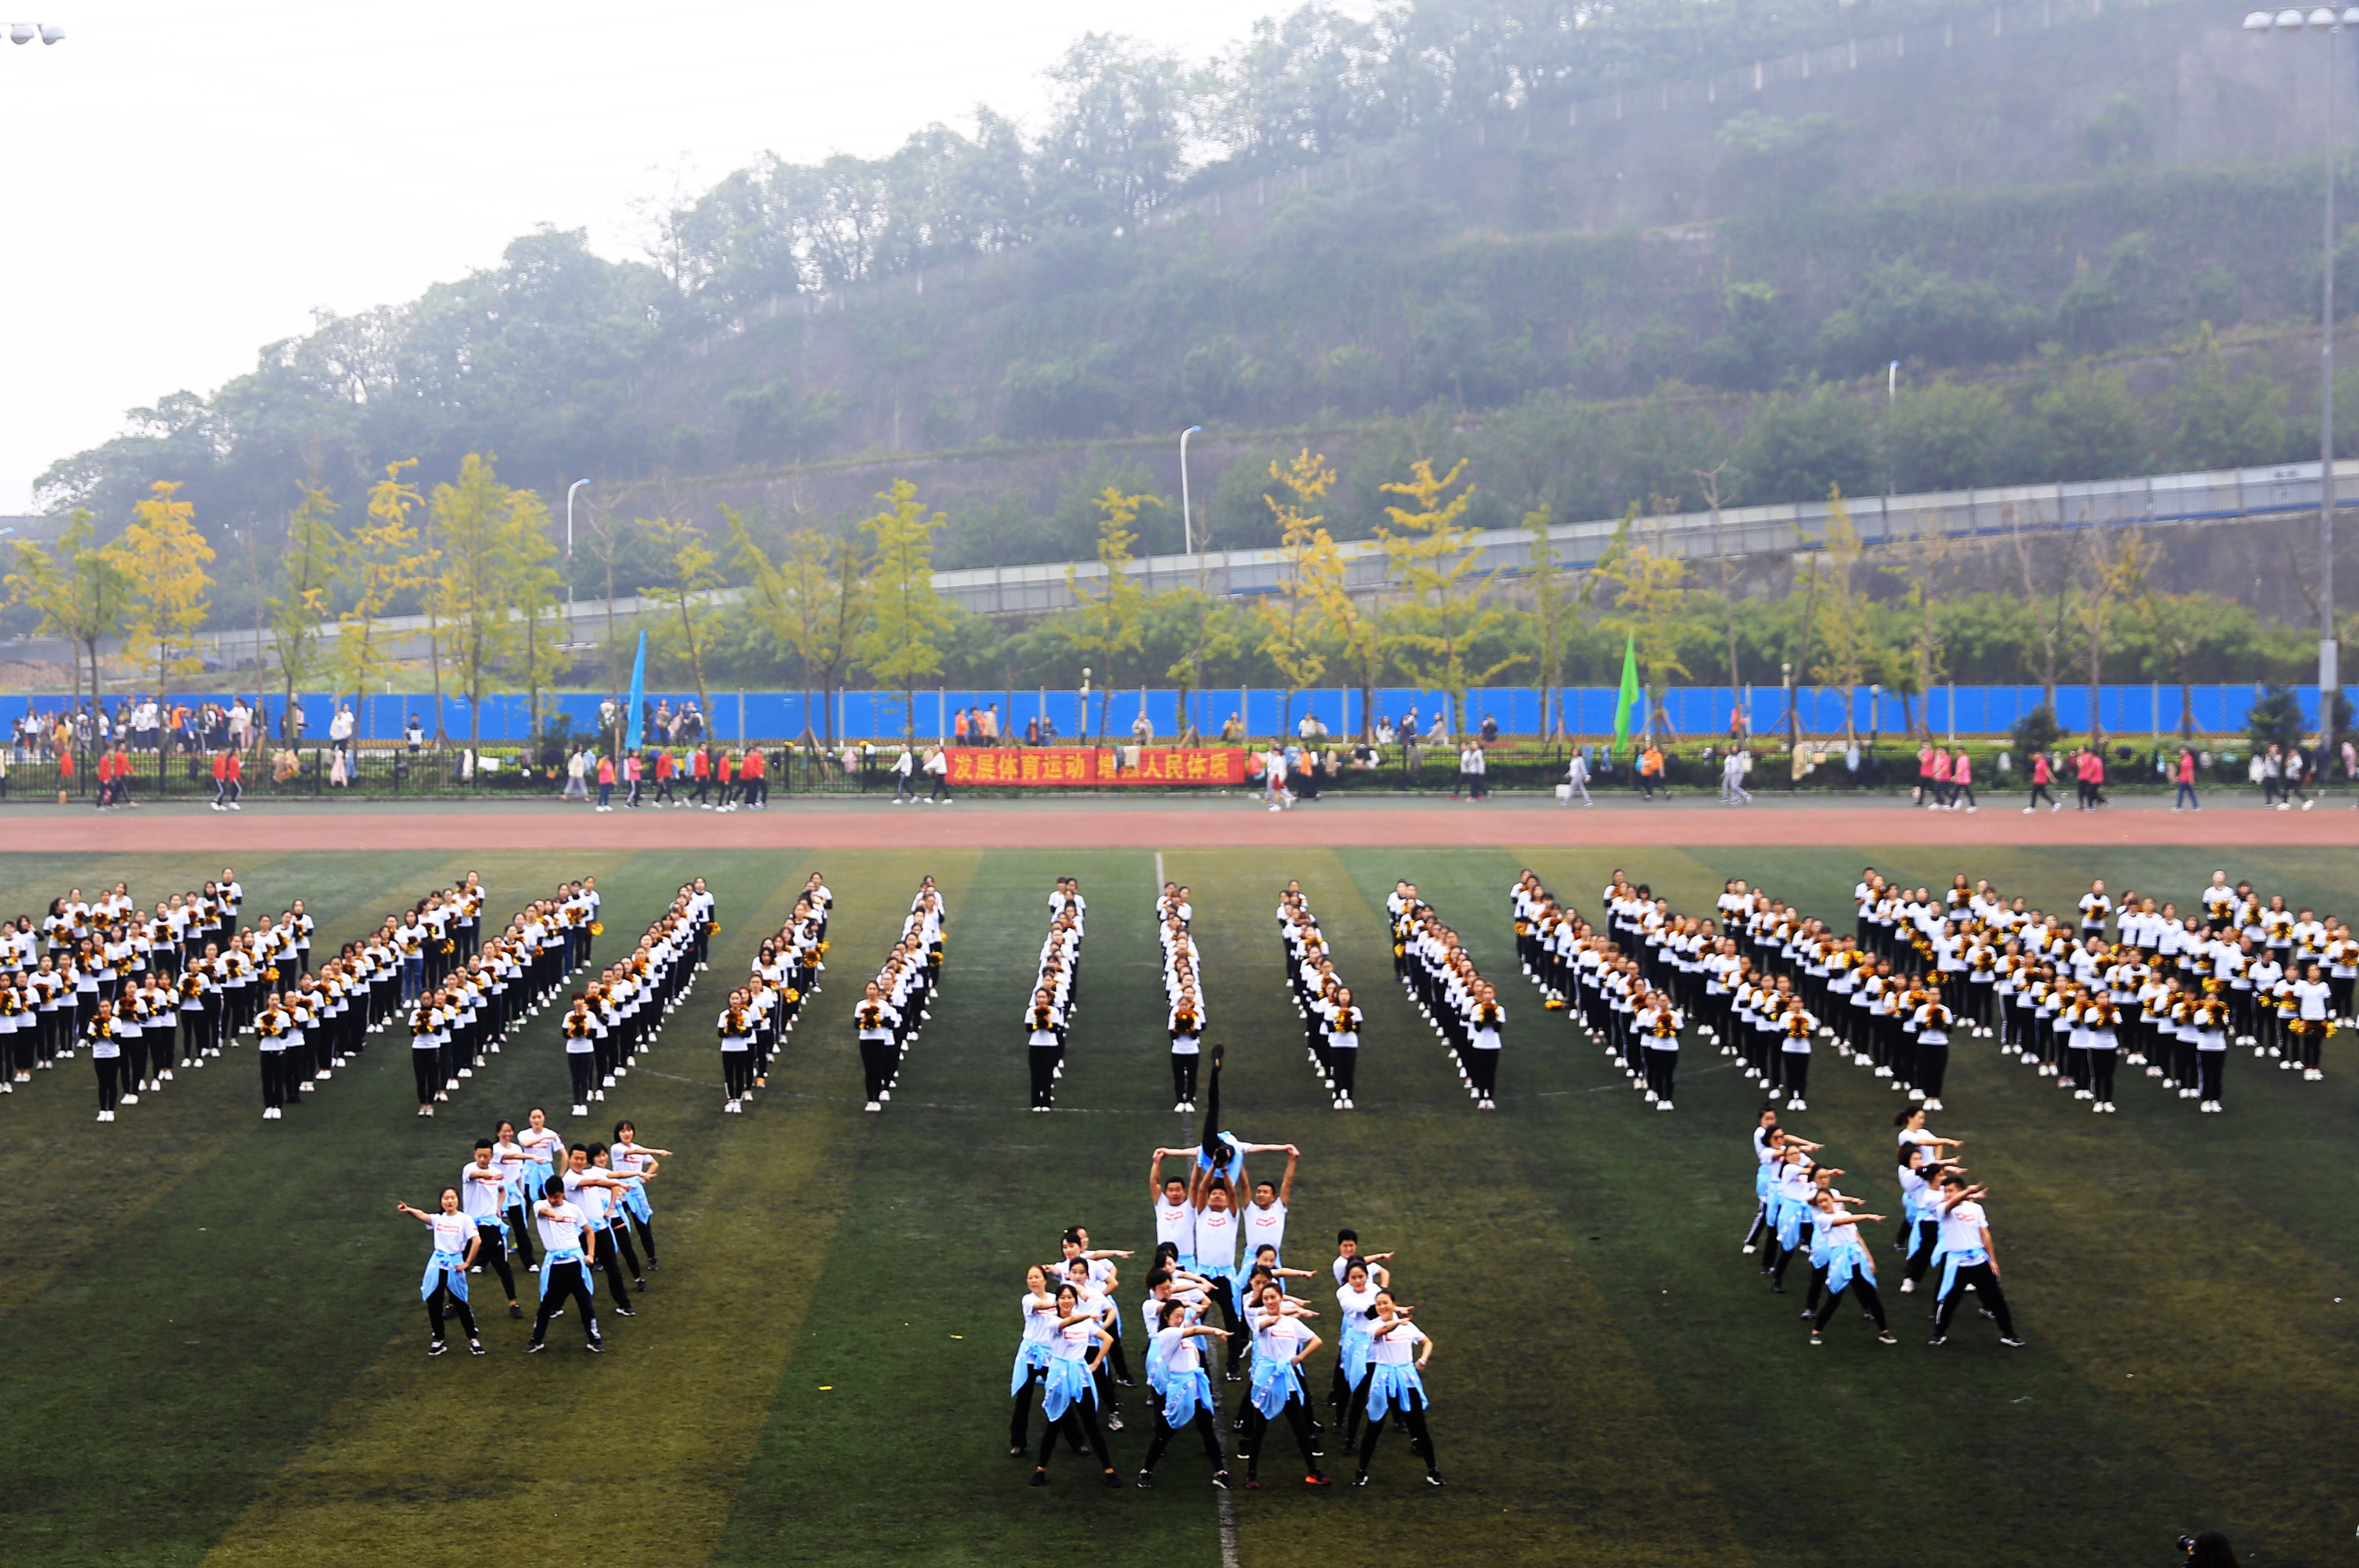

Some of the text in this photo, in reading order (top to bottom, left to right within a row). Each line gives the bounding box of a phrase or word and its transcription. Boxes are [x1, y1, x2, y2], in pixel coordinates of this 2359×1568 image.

[953, 753, 1085, 780] 发展体育运动
